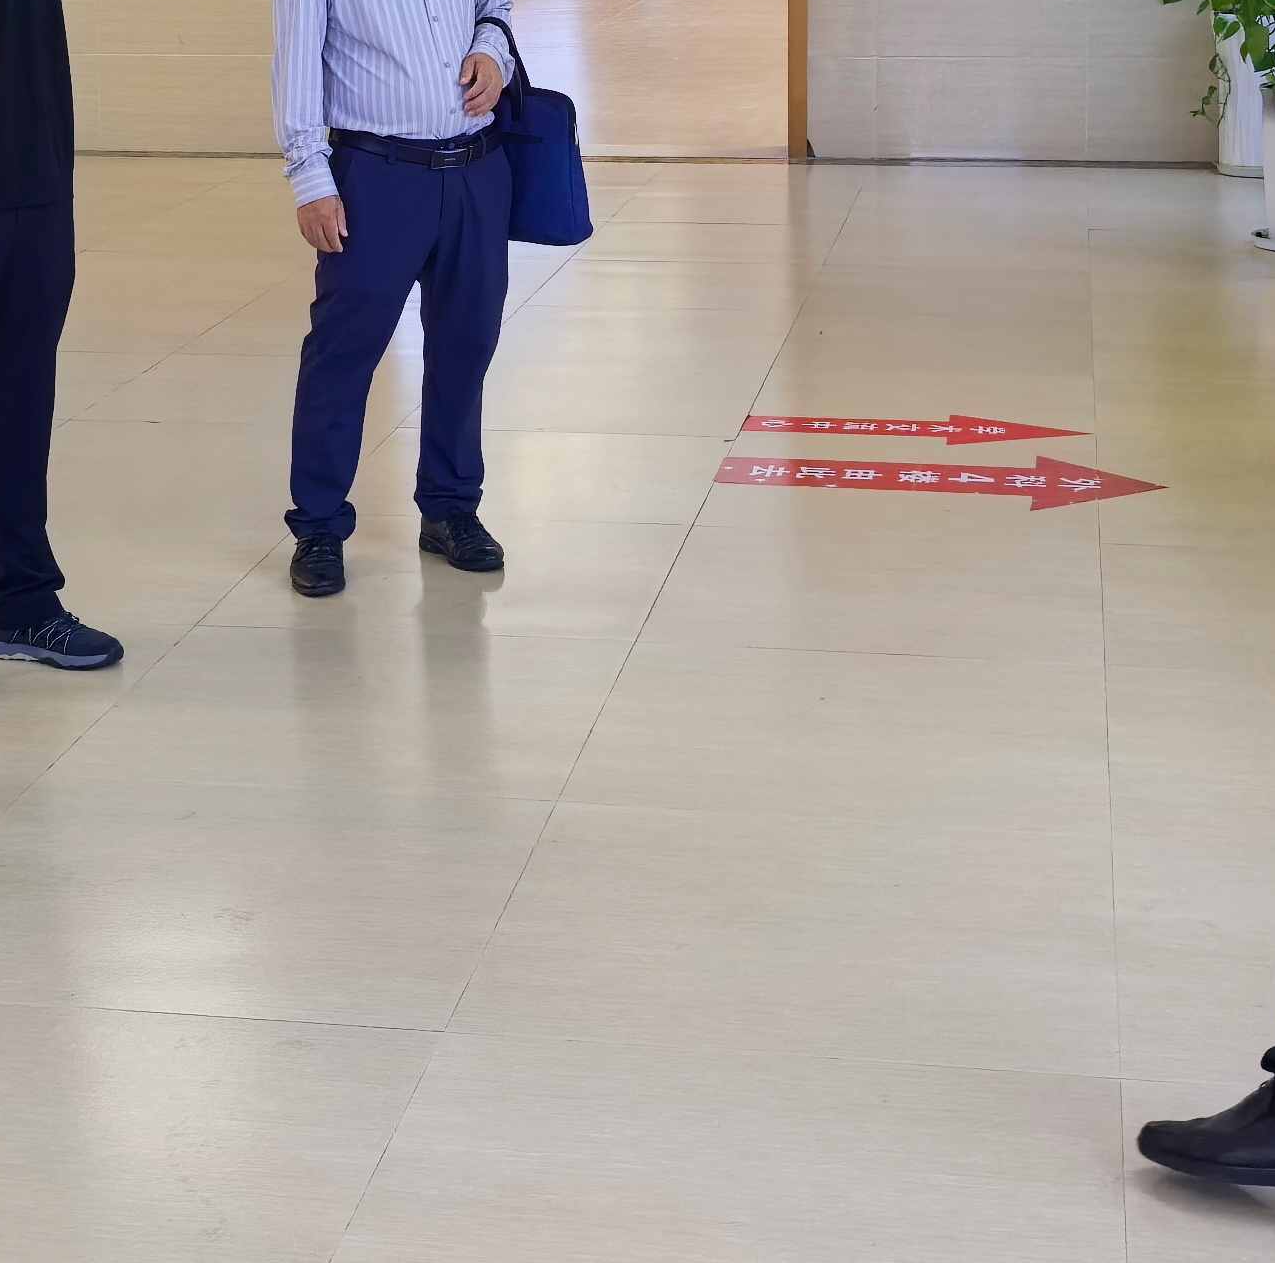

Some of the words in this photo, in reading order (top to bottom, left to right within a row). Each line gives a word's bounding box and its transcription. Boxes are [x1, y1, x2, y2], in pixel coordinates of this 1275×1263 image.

[750, 462, 1102, 492] 外科4楼由此去
